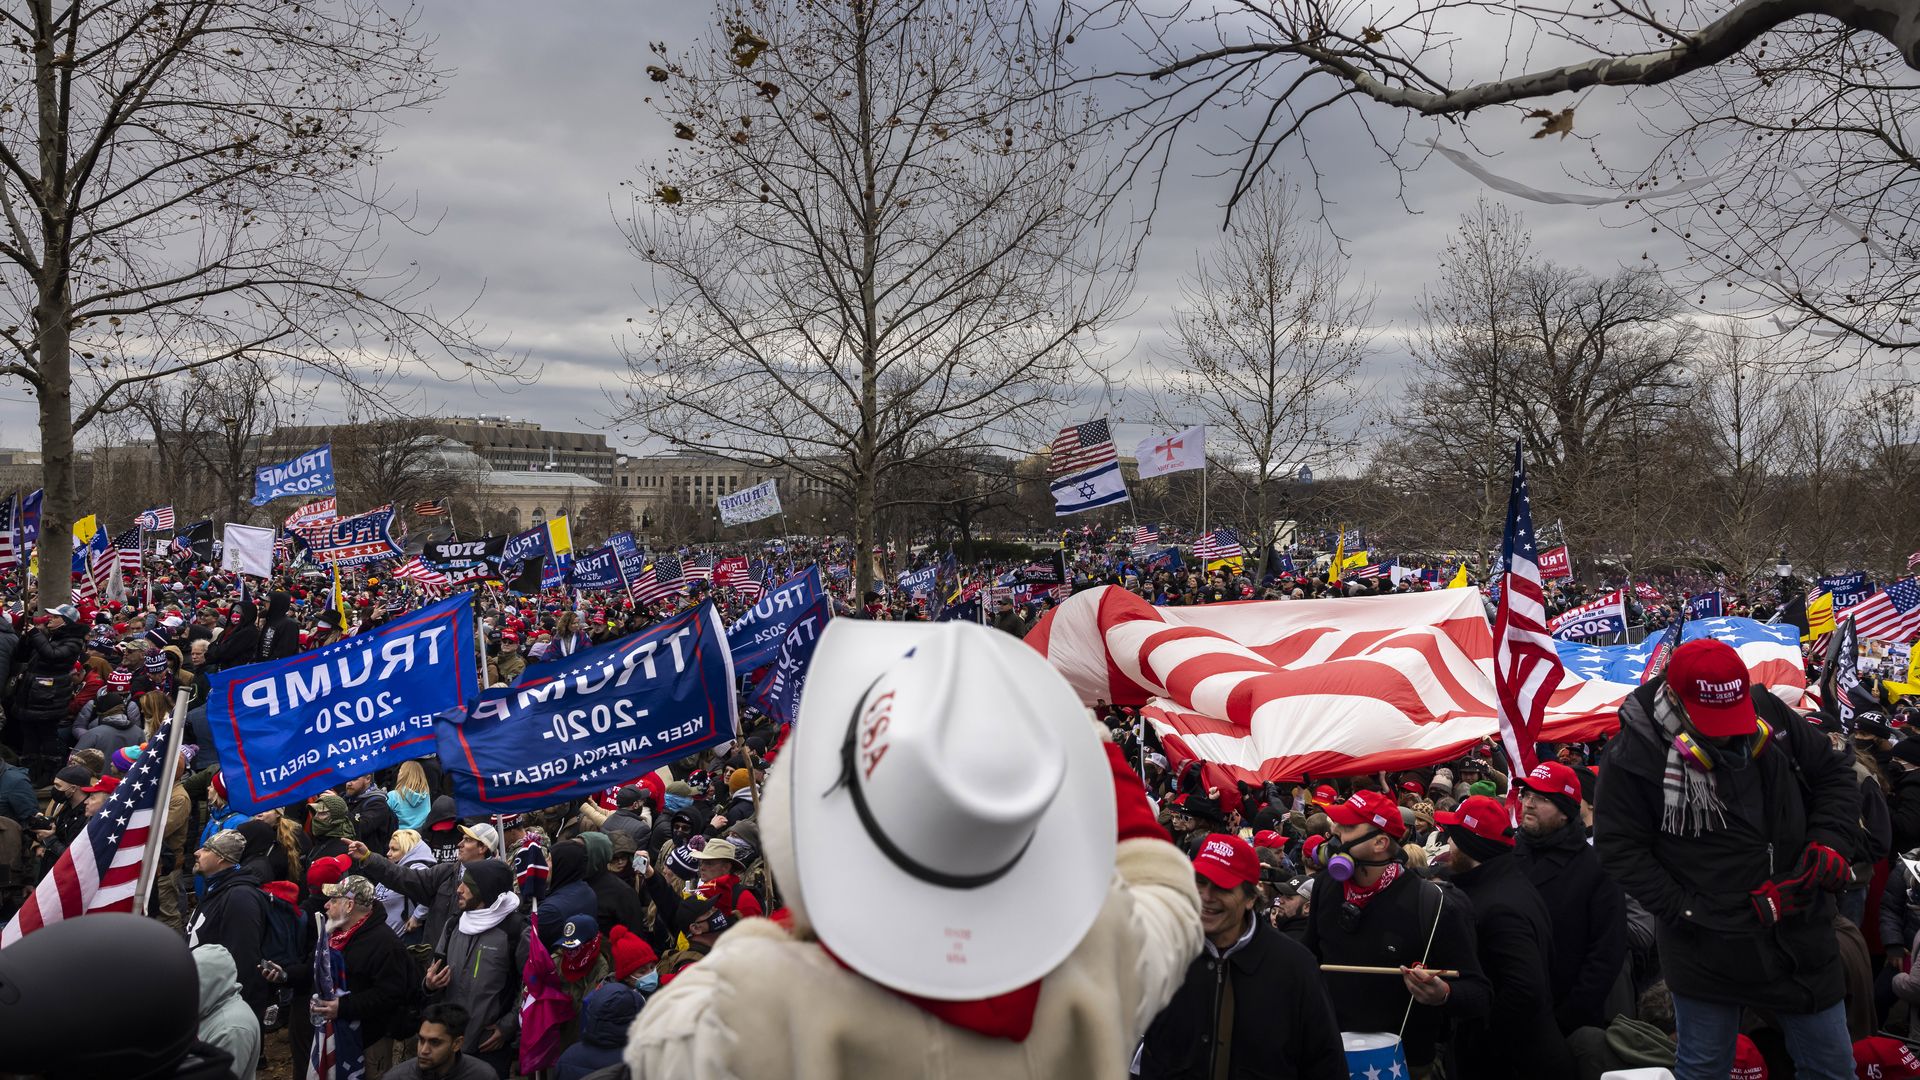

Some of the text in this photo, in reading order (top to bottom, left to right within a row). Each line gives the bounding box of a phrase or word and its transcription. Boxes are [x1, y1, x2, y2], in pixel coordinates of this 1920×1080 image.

[1697, 679, 1742, 691] Trump
[861, 689, 895, 781] USA
[1867, 1063, 1882, 1079] 45
